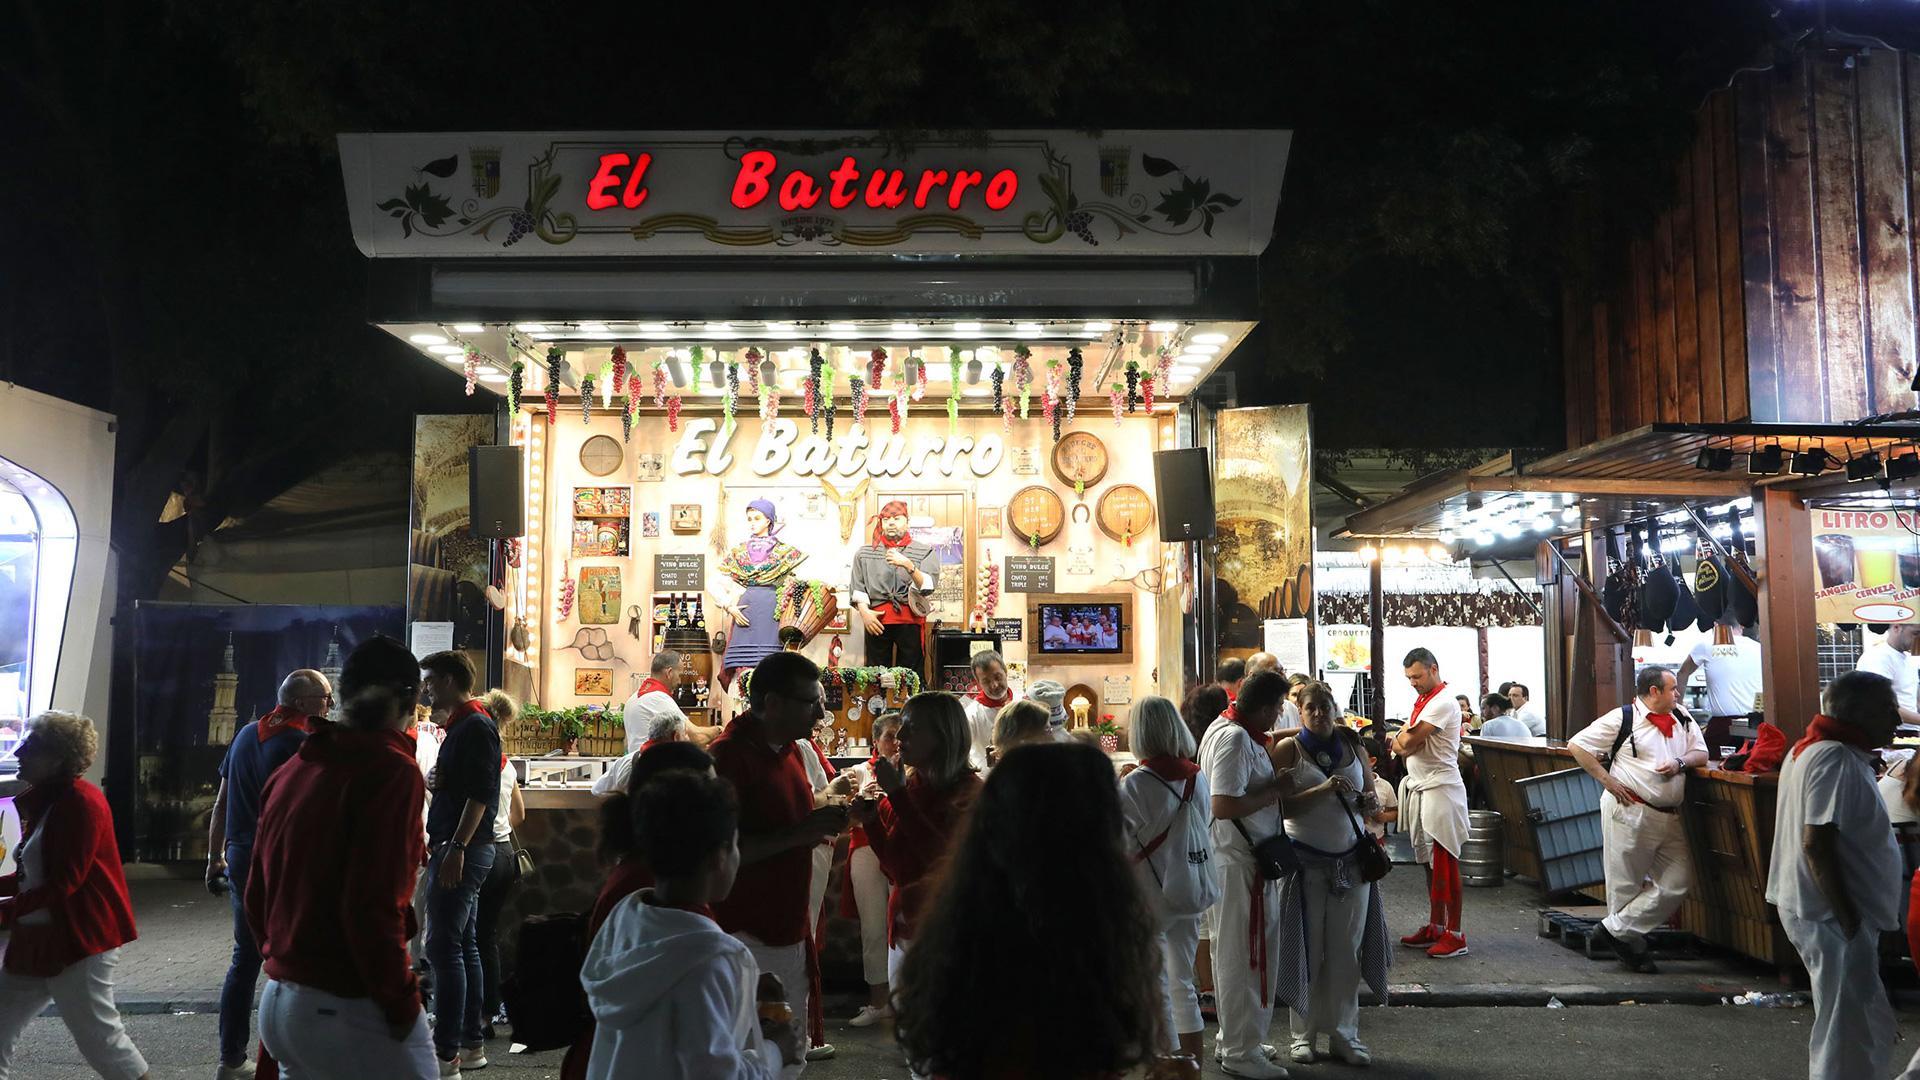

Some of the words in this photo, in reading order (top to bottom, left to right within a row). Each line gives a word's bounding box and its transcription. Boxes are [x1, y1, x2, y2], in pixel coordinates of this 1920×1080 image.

[586, 152, 652, 211] El
[730, 149, 1019, 212] Baturro
[671, 417, 737, 476] El
[751, 417, 1004, 478] Baturro
[1822, 512, 1889, 529] LITRO
[1815, 583, 1858, 600] SANGRIA
[1855, 583, 1896, 599] CERVEZA
[1897, 609, 1904, 618] €
